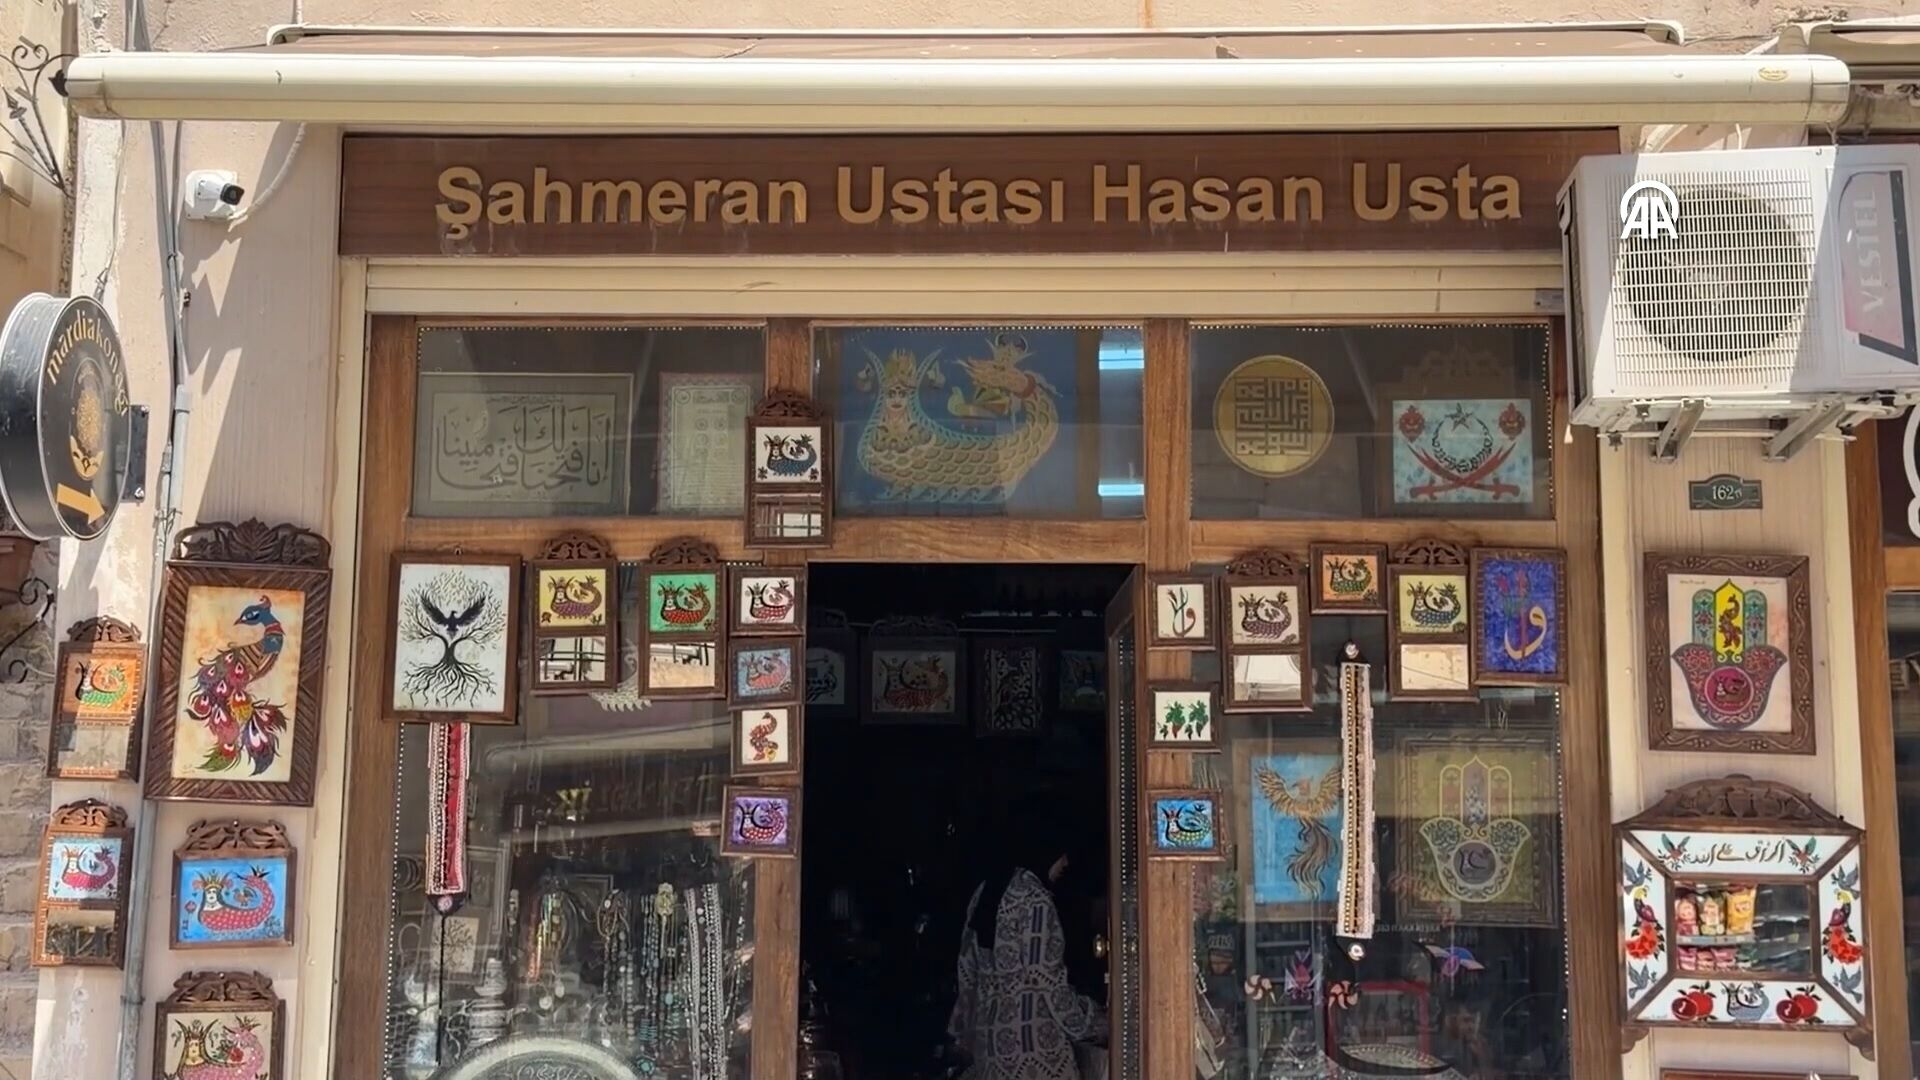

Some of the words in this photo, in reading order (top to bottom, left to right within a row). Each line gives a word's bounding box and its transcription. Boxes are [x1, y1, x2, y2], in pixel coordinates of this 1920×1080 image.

[435, 166, 807, 240] Şahmeran
[837, 165, 1064, 225] Ustası
[1093, 163, 1323, 223] Hasan
[1353, 161, 1521, 222] Usta
[1853, 190, 1884, 313] VESTEL
